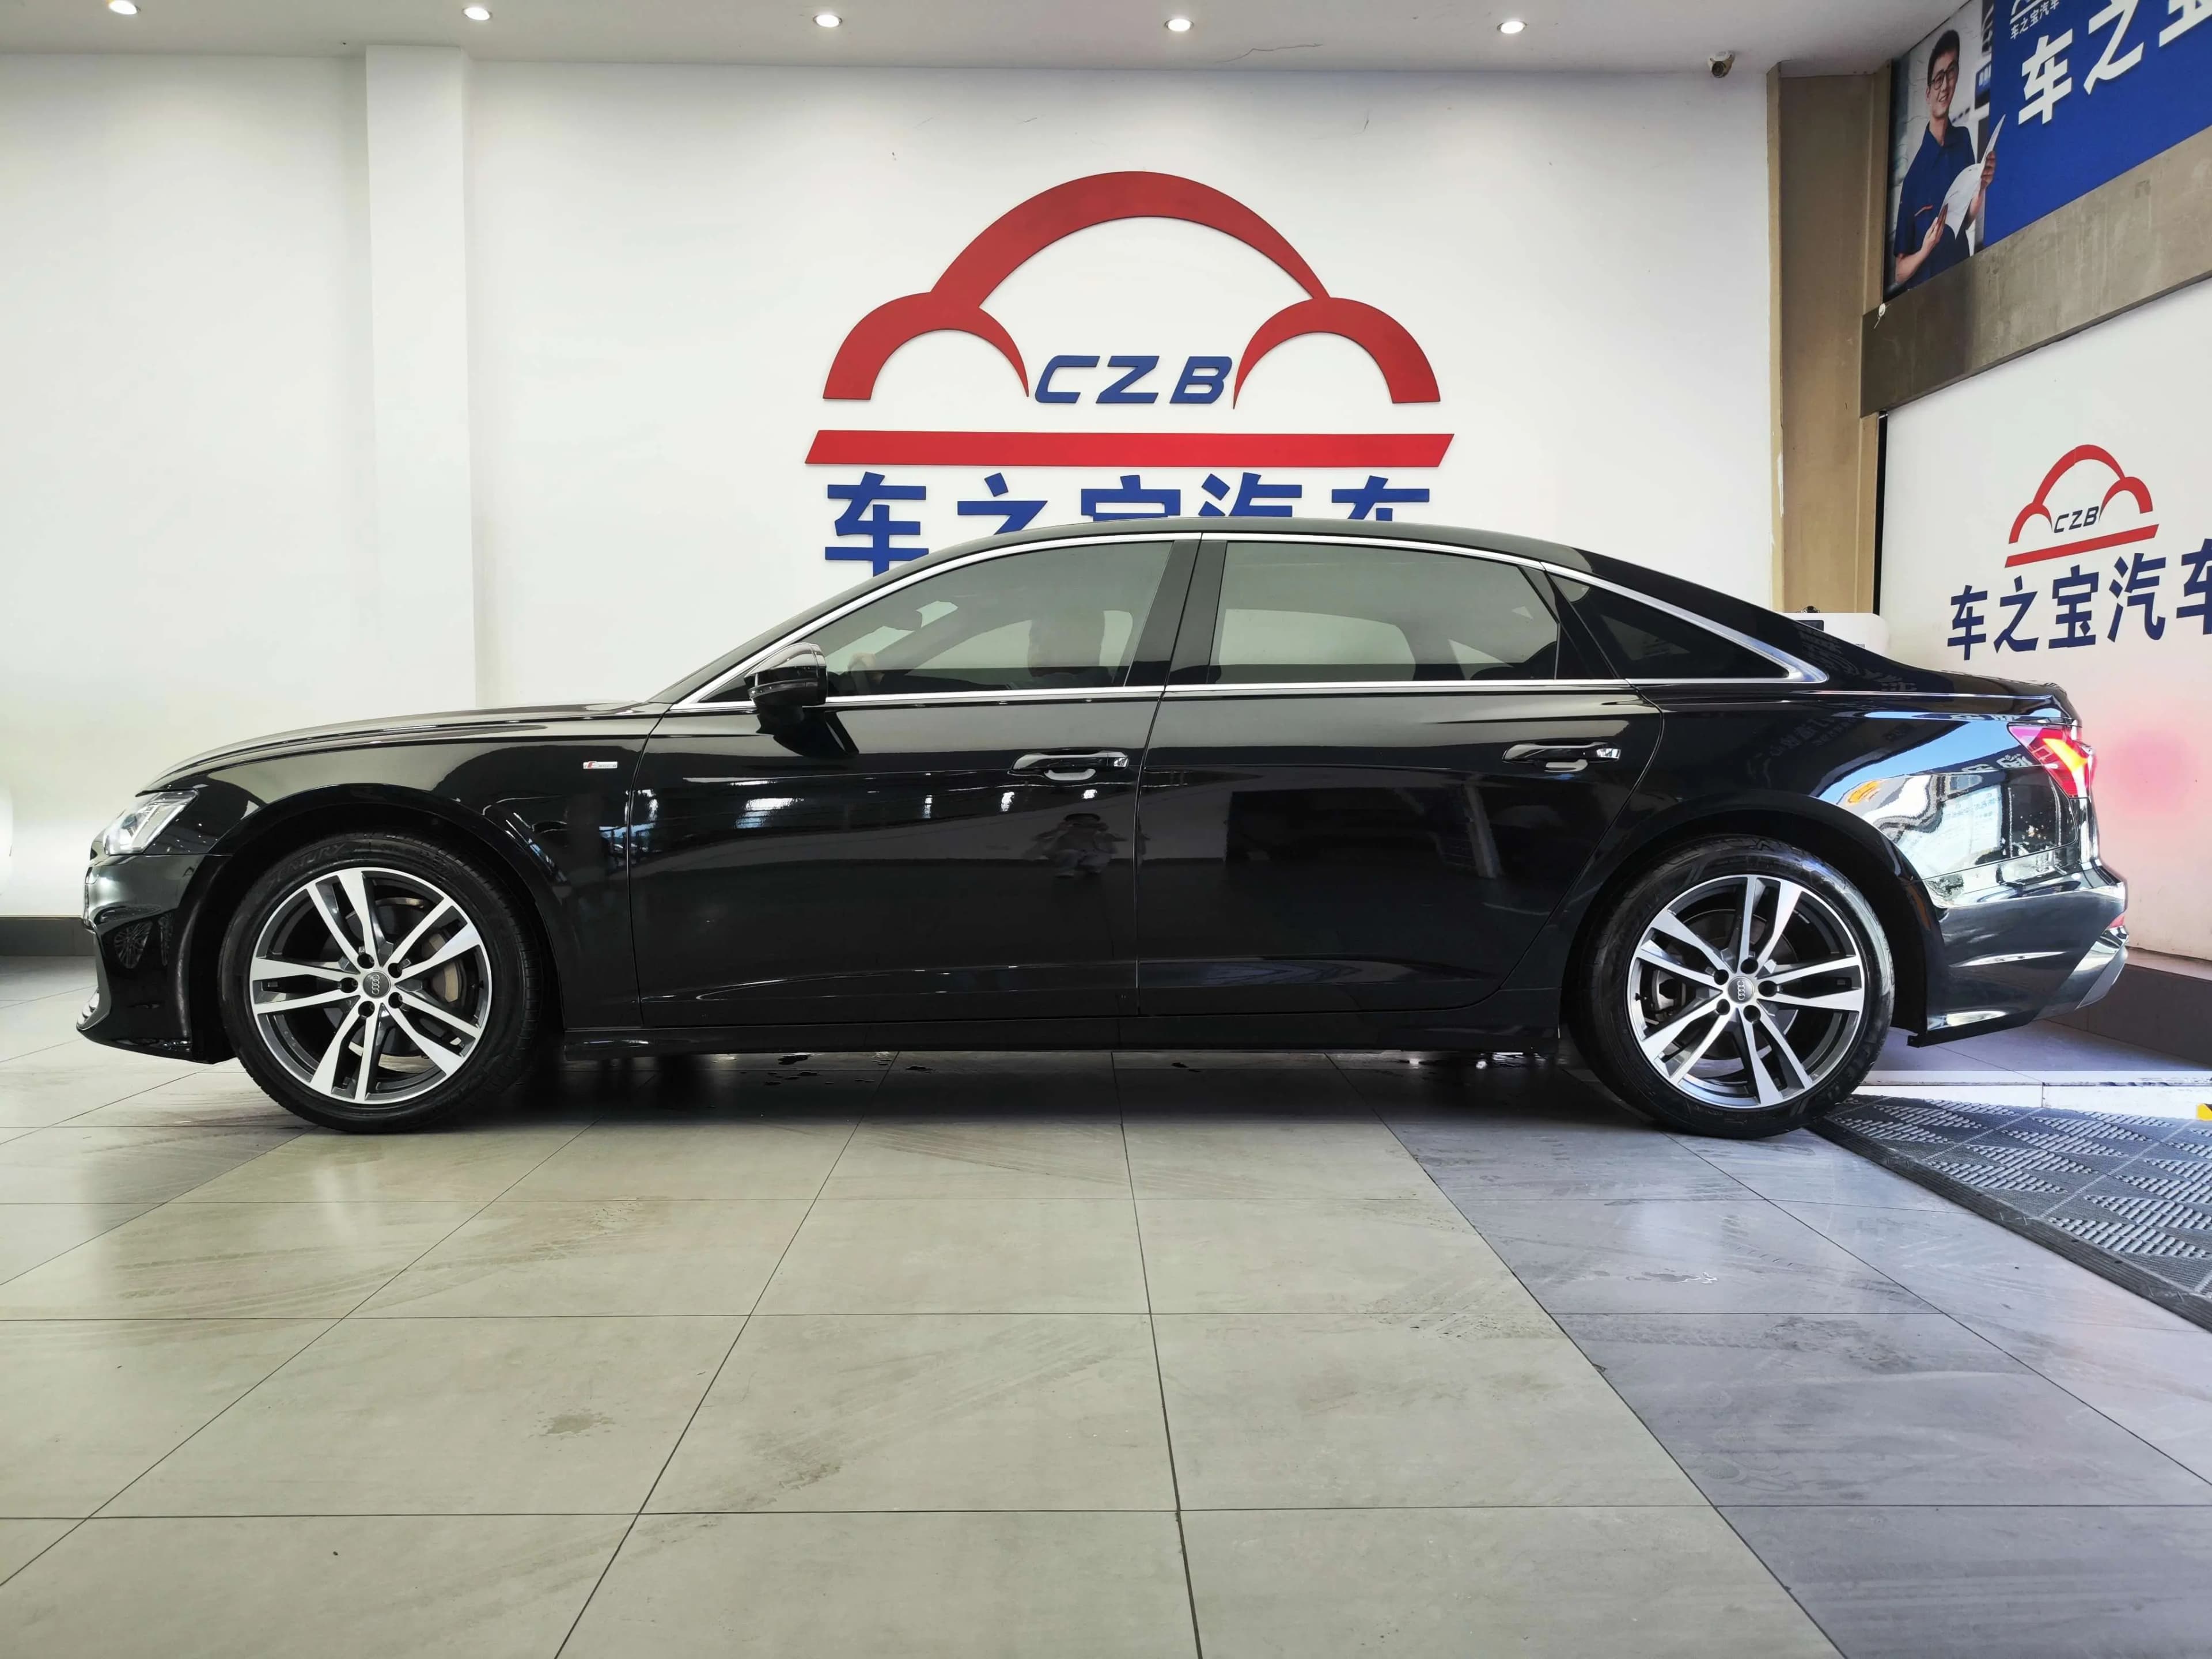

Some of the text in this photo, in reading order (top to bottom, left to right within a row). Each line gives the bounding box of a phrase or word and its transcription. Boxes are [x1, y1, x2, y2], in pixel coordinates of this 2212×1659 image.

[2018, 0, 2212, 125] 车之
[1035, 354, 1233, 404] CZB
[2054, 506, 2099, 533] CZB
